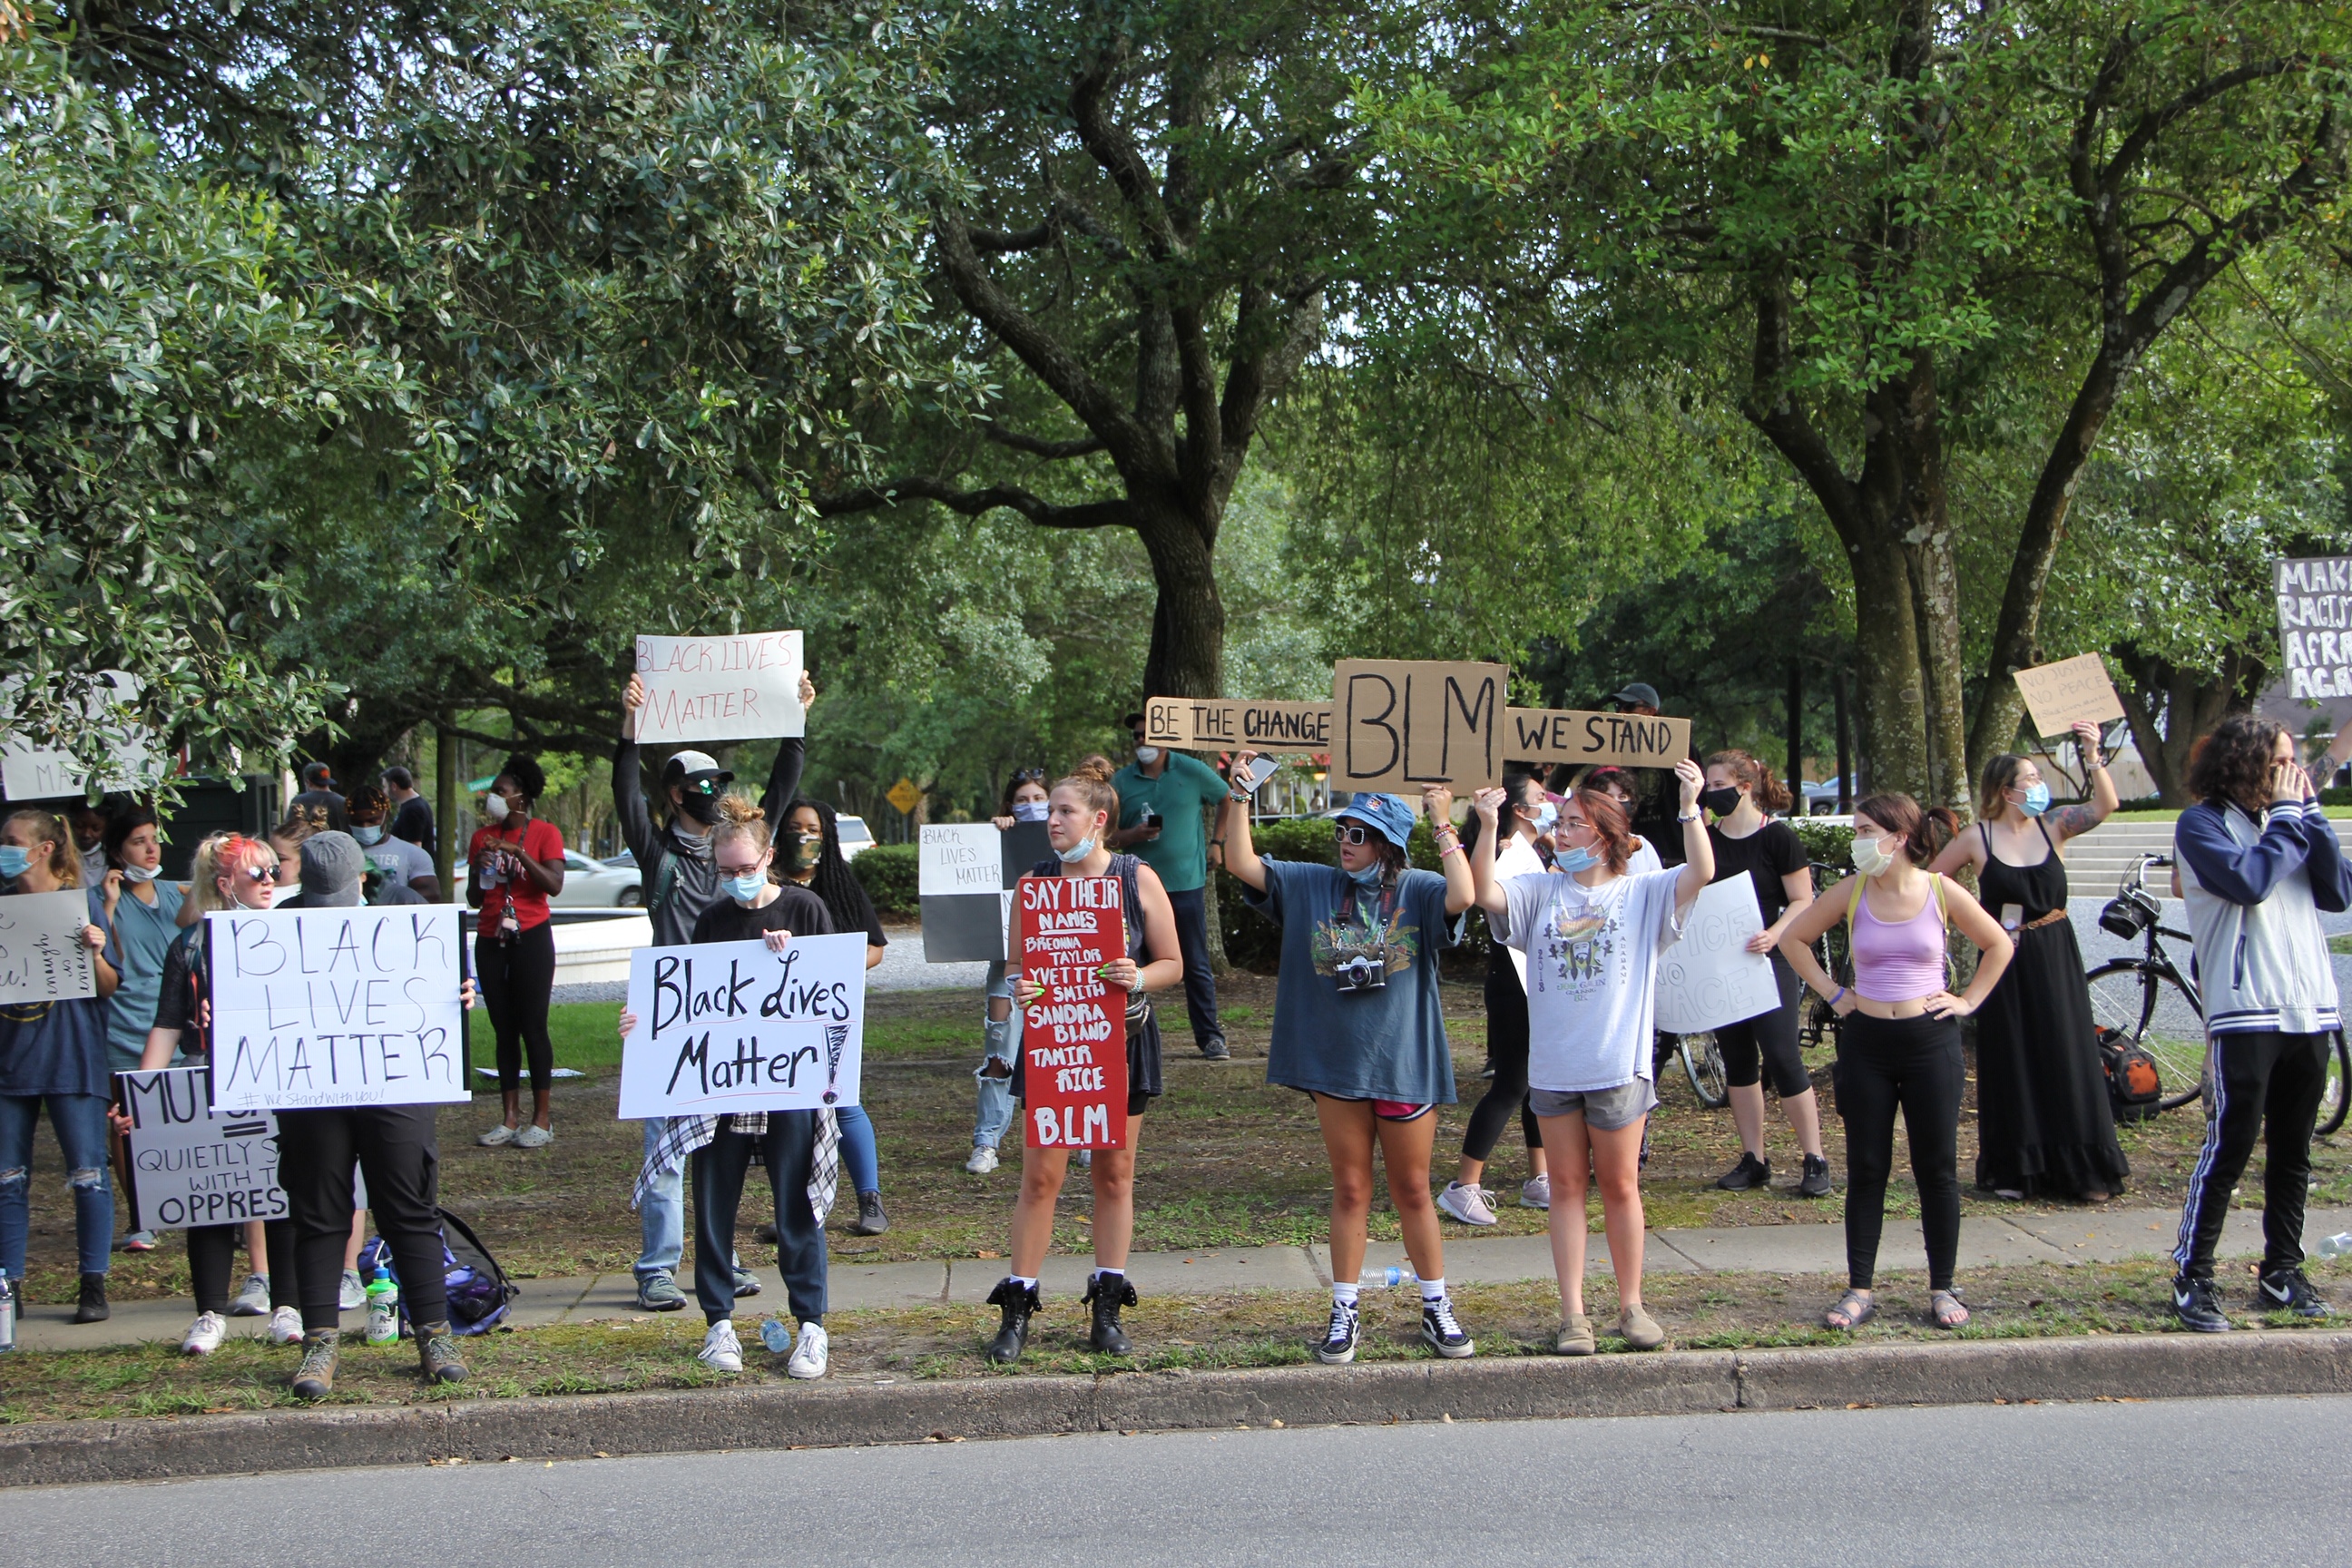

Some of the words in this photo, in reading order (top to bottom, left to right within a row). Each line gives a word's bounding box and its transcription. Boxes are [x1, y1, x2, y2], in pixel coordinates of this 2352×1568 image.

[2279, 560, 2352, 593] MAK
[636, 640, 712, 673] BLACK
[721, 633, 792, 671] LIVES
[2022, 672, 2046, 689] NO
[2048, 657, 2101, 681] JUSTICE
[2290, 666, 2352, 699] AGA
[2030, 690, 2053, 705] NO
[2058, 675, 2107, 697] PEACE
[636, 688, 761, 740] MATTER
[1150, 704, 1179, 735] BE
[1190, 706, 1235, 736] THE
[1243, 708, 1331, 742] CHANGE
[1347, 673, 1495, 782] BLM
[1515, 715, 1571, 750] WE
[1582, 715, 1672, 756] STAND
[940, 847, 977, 865] LIVES
[956, 863, 1002, 885] MATTER
[1023, 878, 1063, 911] SAY
[1066, 877, 1120, 910] THEIR
[1038, 910, 1097, 930] NAMES
[230, 913, 448, 977] BLACK
[1024, 936, 1083, 953] BREONNA
[1048, 948, 1102, 967] TAYLOR
[1029, 966, 1100, 986] YVETTE
[265, 976, 427, 1034] LIVES
[652, 956, 755, 1041] Black
[760, 950, 849, 1021] Lives
[1053, 983, 1106, 1003] SMITH
[1655, 967, 1756, 1024] EACE
[1027, 1003, 1106, 1029] SANDRA
[1053, 1020, 1112, 1044] BLAND
[226, 1027, 452, 1092] MATTER
[1029, 1044, 1093, 1068] TAMIR
[1055, 1065, 1106, 1093] RICE
[1034, 1103, 1117, 1146] B.L.M.
[137, 1141, 252, 1172] QUIETLY
[189, 1170, 251, 1191] WITH
